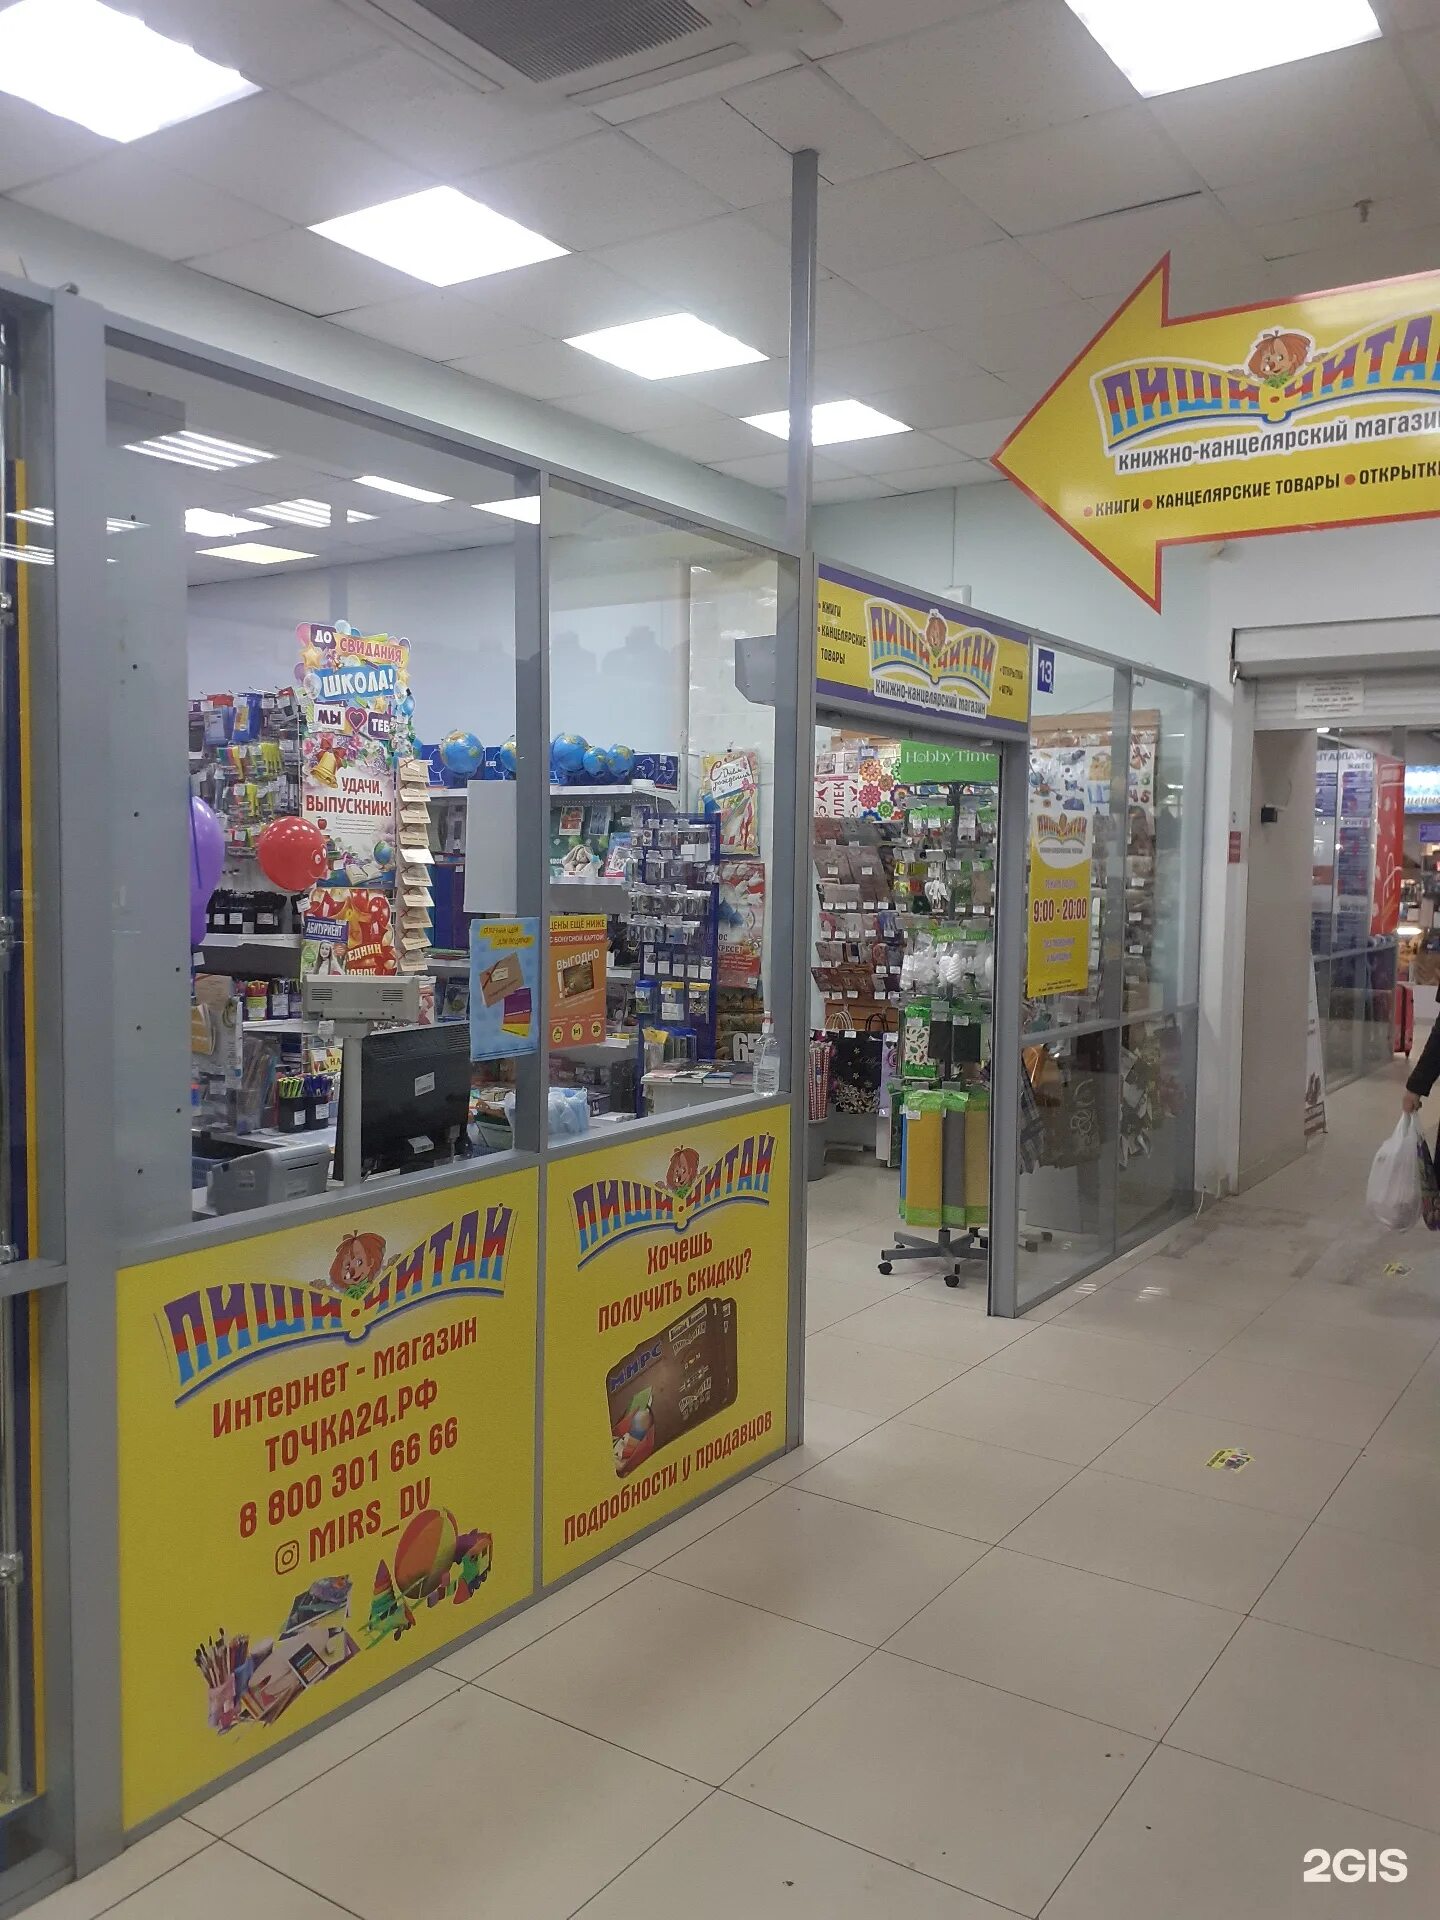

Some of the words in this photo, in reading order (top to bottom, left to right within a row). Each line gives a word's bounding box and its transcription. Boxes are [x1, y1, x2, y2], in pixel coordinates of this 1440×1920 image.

[1102, 366, 1260, 437] ПИШИ
[1118, 420, 1347, 471] книжно-канцелярский
[1354, 409, 1440, 439] магази
[1156, 482, 1271, 509] КАНЦЕЛЯРСКИЕ
[1275, 472, 1340, 494] ТОВАРЫ
[1095, 497, 1140, 517] КНИГИ
[821, 600, 841, 617] КНИГИ
[314, 629, 332, 644] ДО
[821, 624, 866, 647] КАНЦЕЛЯРСКИЕ
[821, 647, 845, 665] ТОВАРЫ
[322, 667, 395, 697] ШКОЛА!
[1039, 659, 1053, 684] 13
[316, 709, 342, 725] МЫ
[958, 697, 986, 714] магазин
[905, 750, 952, 768] Hobby
[957, 750, 996, 764] Time
[341, 777, 383, 796] УДАЧИ,
[306, 794, 393, 817] ВЫПУСКНИК!
[1033, 899, 1054, 922] 9:00
[1063, 898, 1087, 920] 20:00
[306, 921, 343, 936] АБИТУРИЕНТ
[586, 919, 606, 929] НИЖЕ
[556, 948, 600, 970] ВЫГОДНО
[572, 1179, 674, 1255] ПИШИ
[647, 1231, 713, 1276] Хочешь
[598, 1277, 684, 1334] получить
[686, 1247, 753, 1295] скидку?
[163, 1282, 343, 1387] ПИШИ
[213, 1361, 350, 1439] Интернет
[373, 1316, 477, 1380] магазин
[264, 1378, 438, 1473] ТОЧКА24.РФ
[239, 1501, 258, 1539] 8
[268, 1474, 323, 1526] 800
[331, 1449, 379, 1501] 301
[390, 1432, 421, 1473] 66
[428, 1416, 459, 1456] 66
[563, 1460, 678, 1546] Подробности
[682, 1458, 691, 1482] у
[695, 1410, 773, 1474] продавцов
[309, 1476, 431, 1563] MIRS_DV
